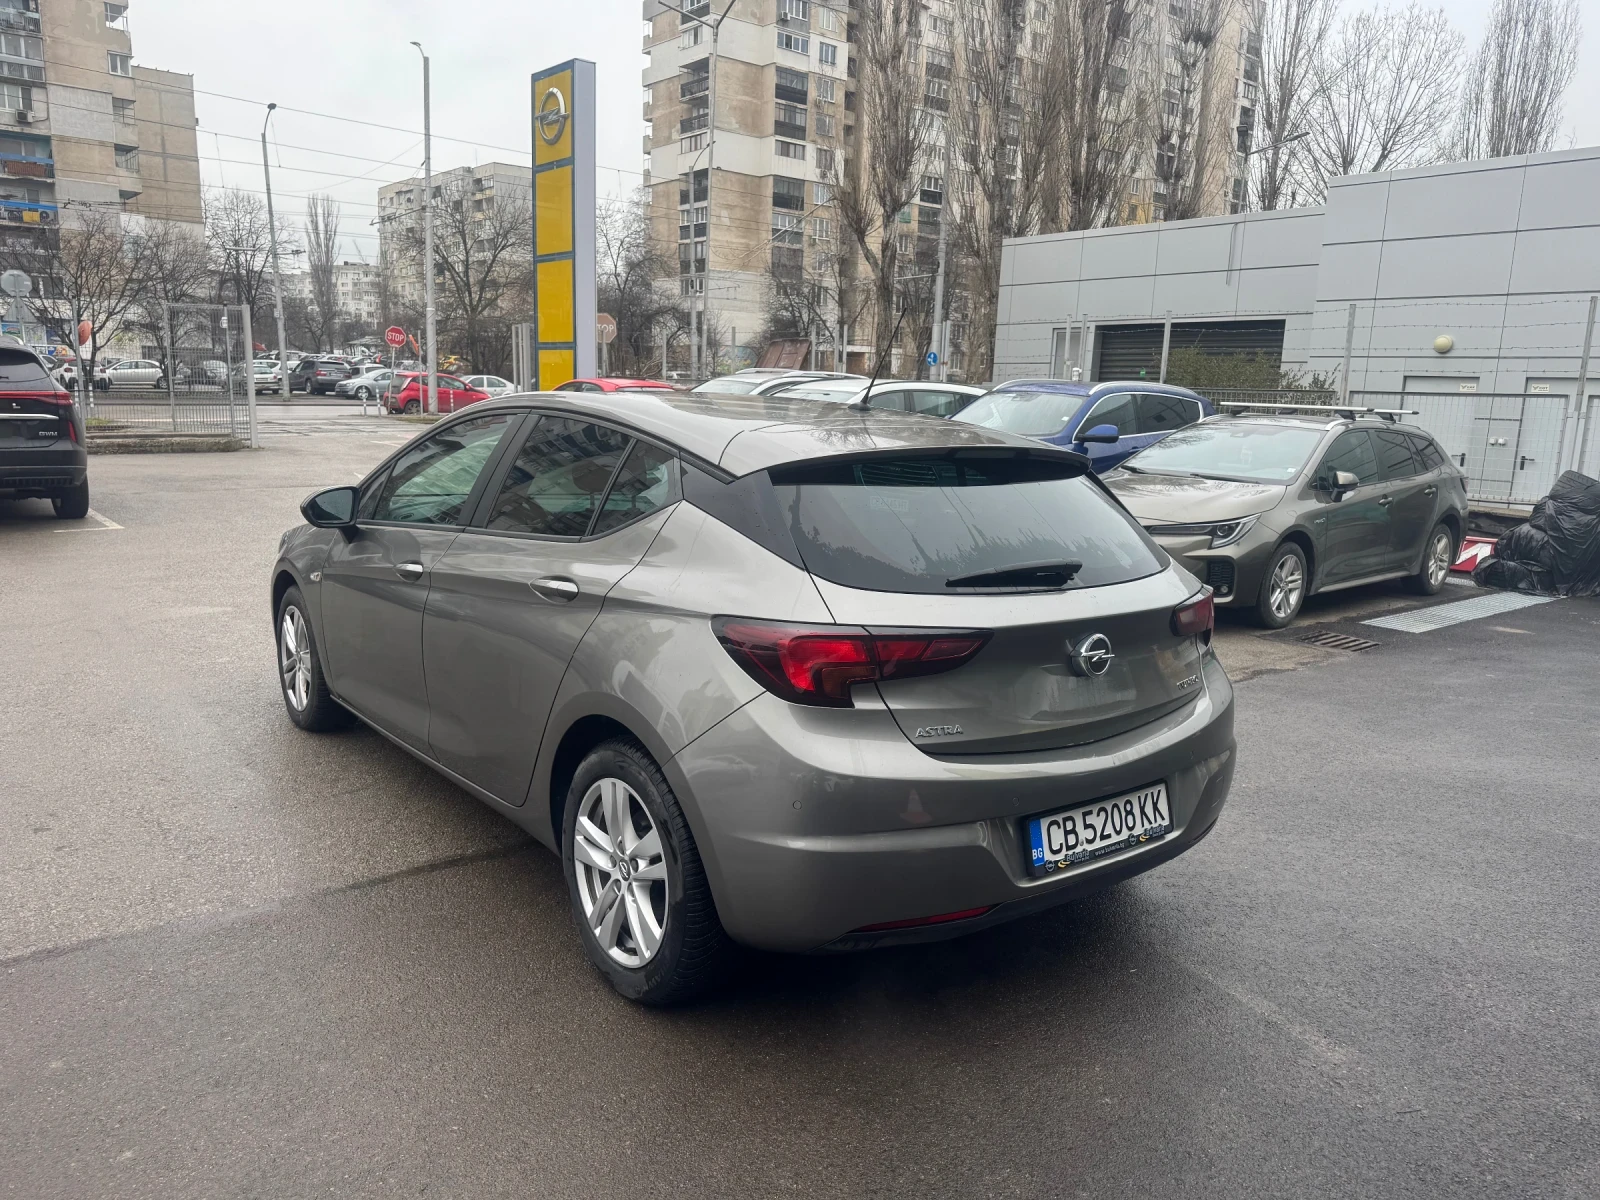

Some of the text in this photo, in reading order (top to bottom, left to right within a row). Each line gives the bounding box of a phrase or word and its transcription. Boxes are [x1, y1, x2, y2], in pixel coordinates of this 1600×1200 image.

[597, 324, 614, 332] TOP
[388, 332, 404, 341] STOP
[915, 725, 964, 738] ASTRA
[1032, 848, 1045, 860] BG
